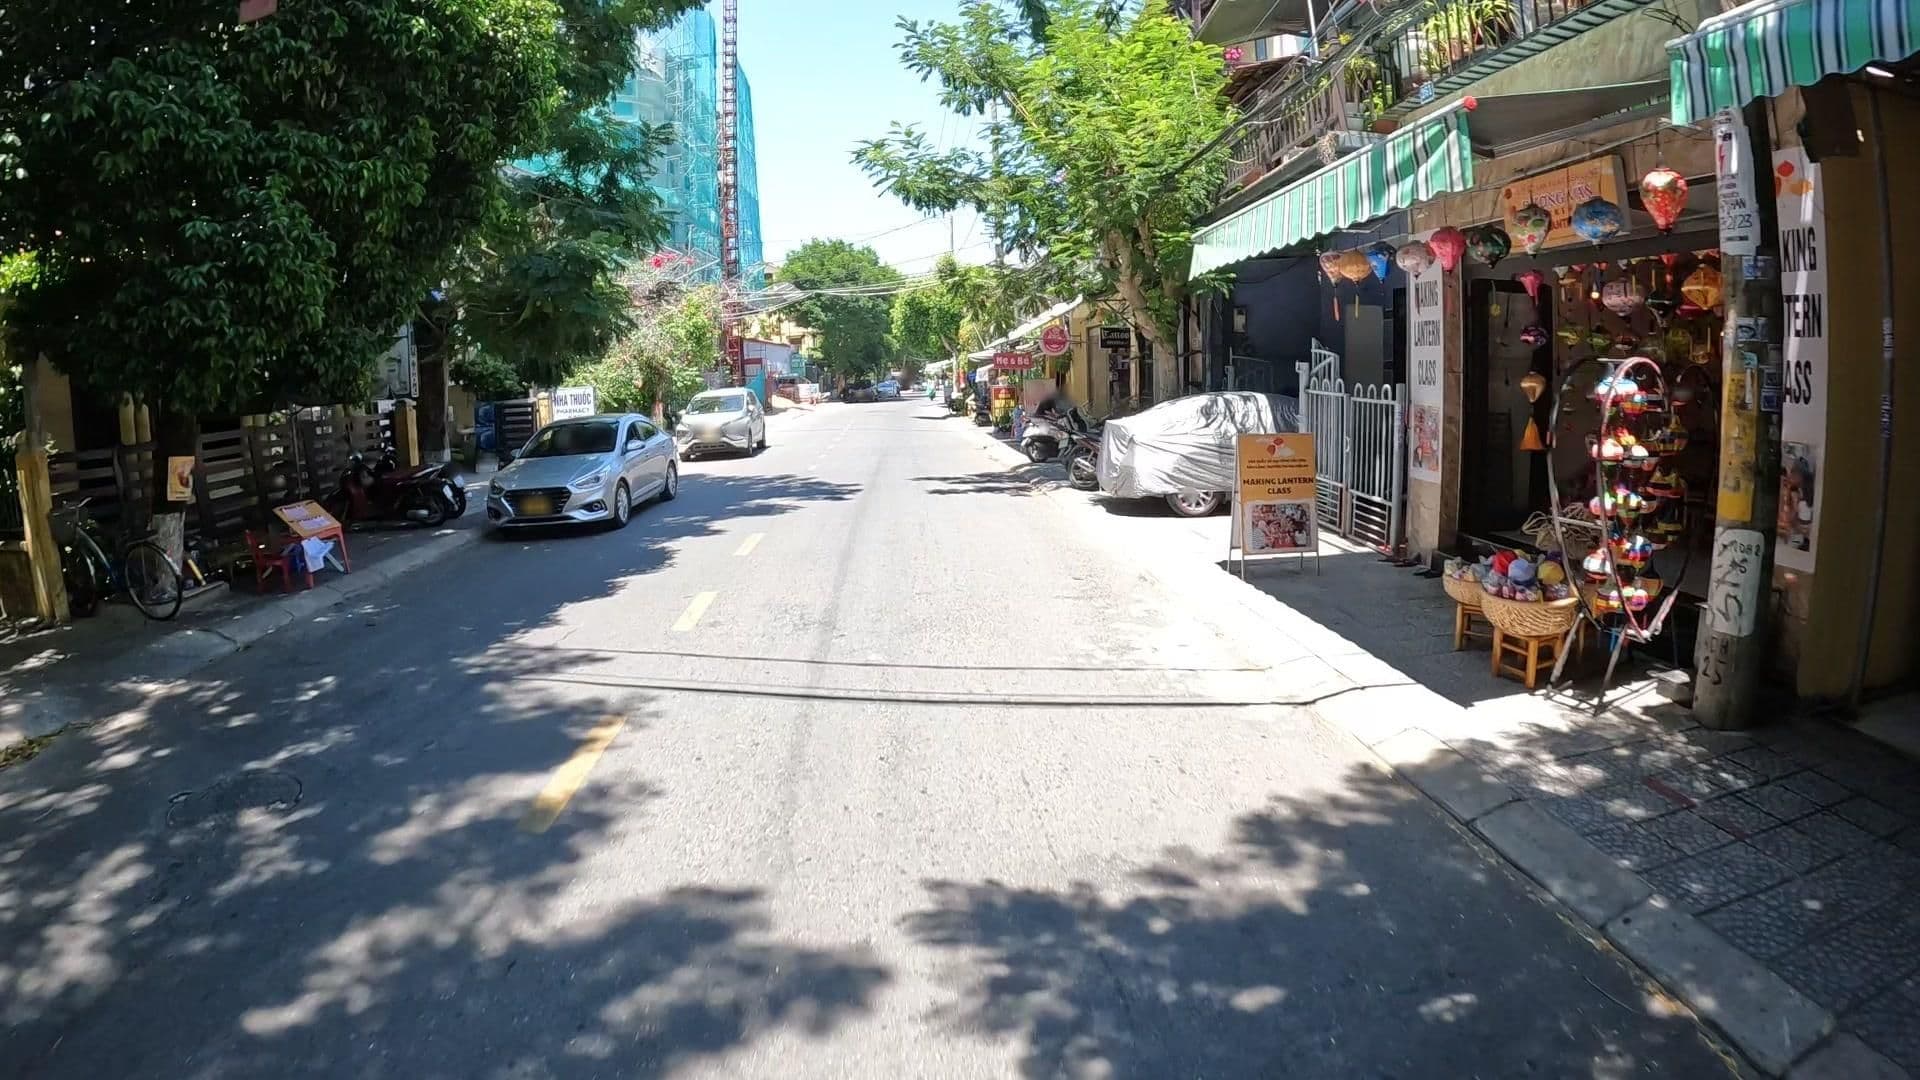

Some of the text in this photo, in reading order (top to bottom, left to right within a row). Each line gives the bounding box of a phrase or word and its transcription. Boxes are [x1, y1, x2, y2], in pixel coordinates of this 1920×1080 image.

[1414, 320, 1440, 346] LANTERN
[1417, 360, 1436, 386] CLASS
[1278, 476, 1314, 484] LANTERN
